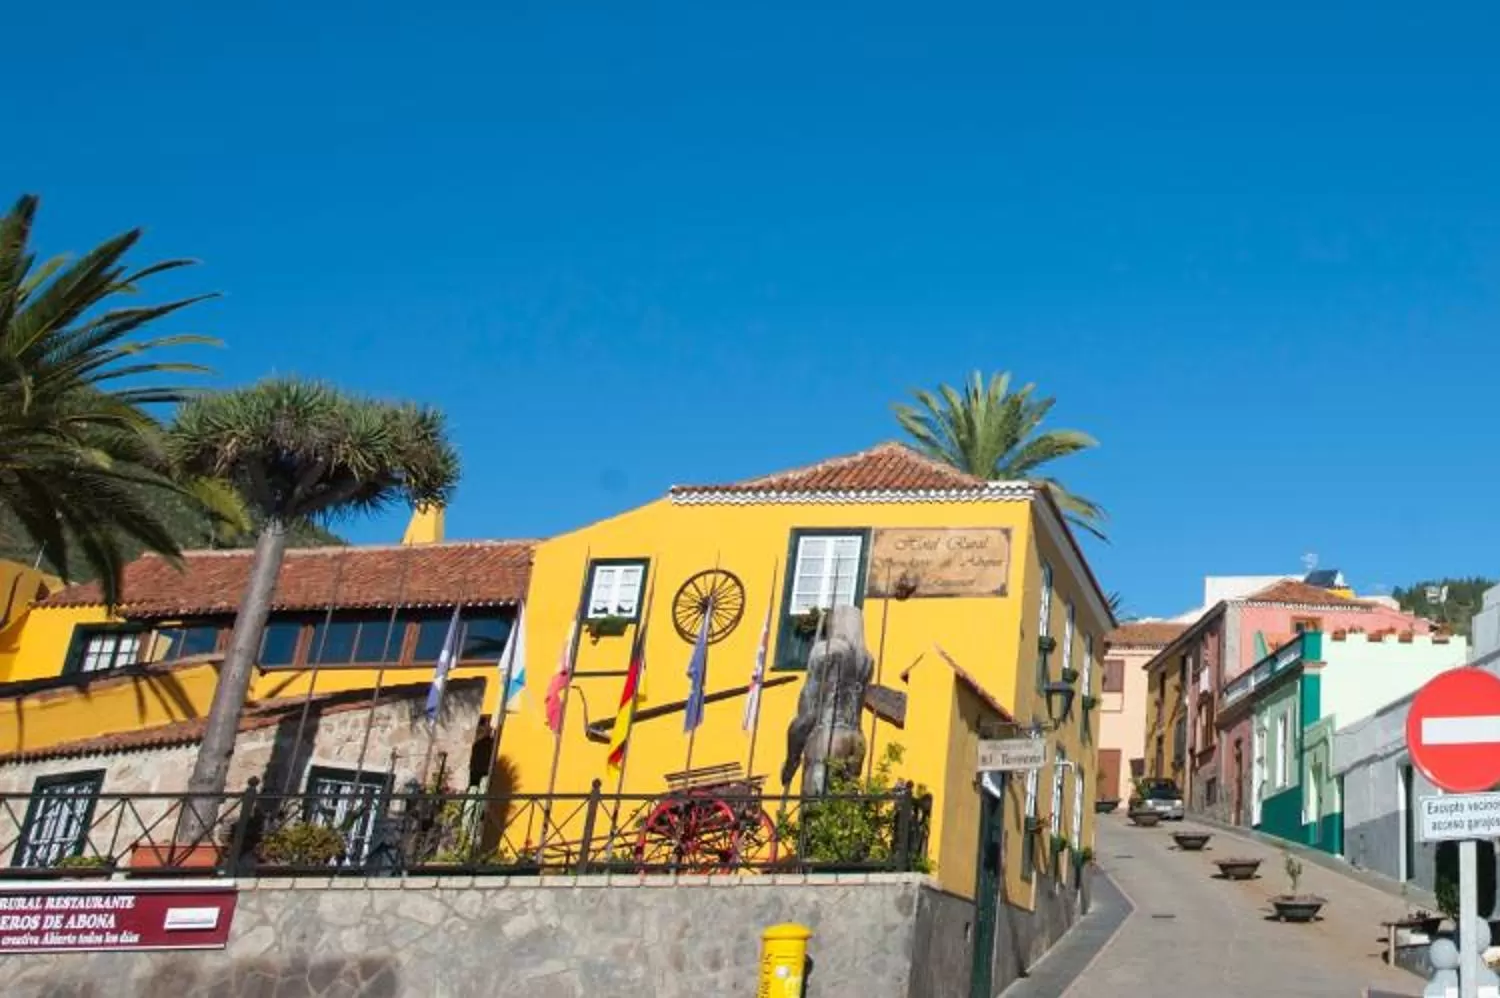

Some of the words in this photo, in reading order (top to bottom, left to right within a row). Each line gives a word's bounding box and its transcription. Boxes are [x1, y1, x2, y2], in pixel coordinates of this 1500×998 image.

[1427, 801, 1464, 816] Excepto
[1431, 819, 1465, 831] acceso
[44, 895, 136, 910] RESTAURANTE
[41, 913, 64, 930] DE
[64, 913, 115, 929] ABONA
